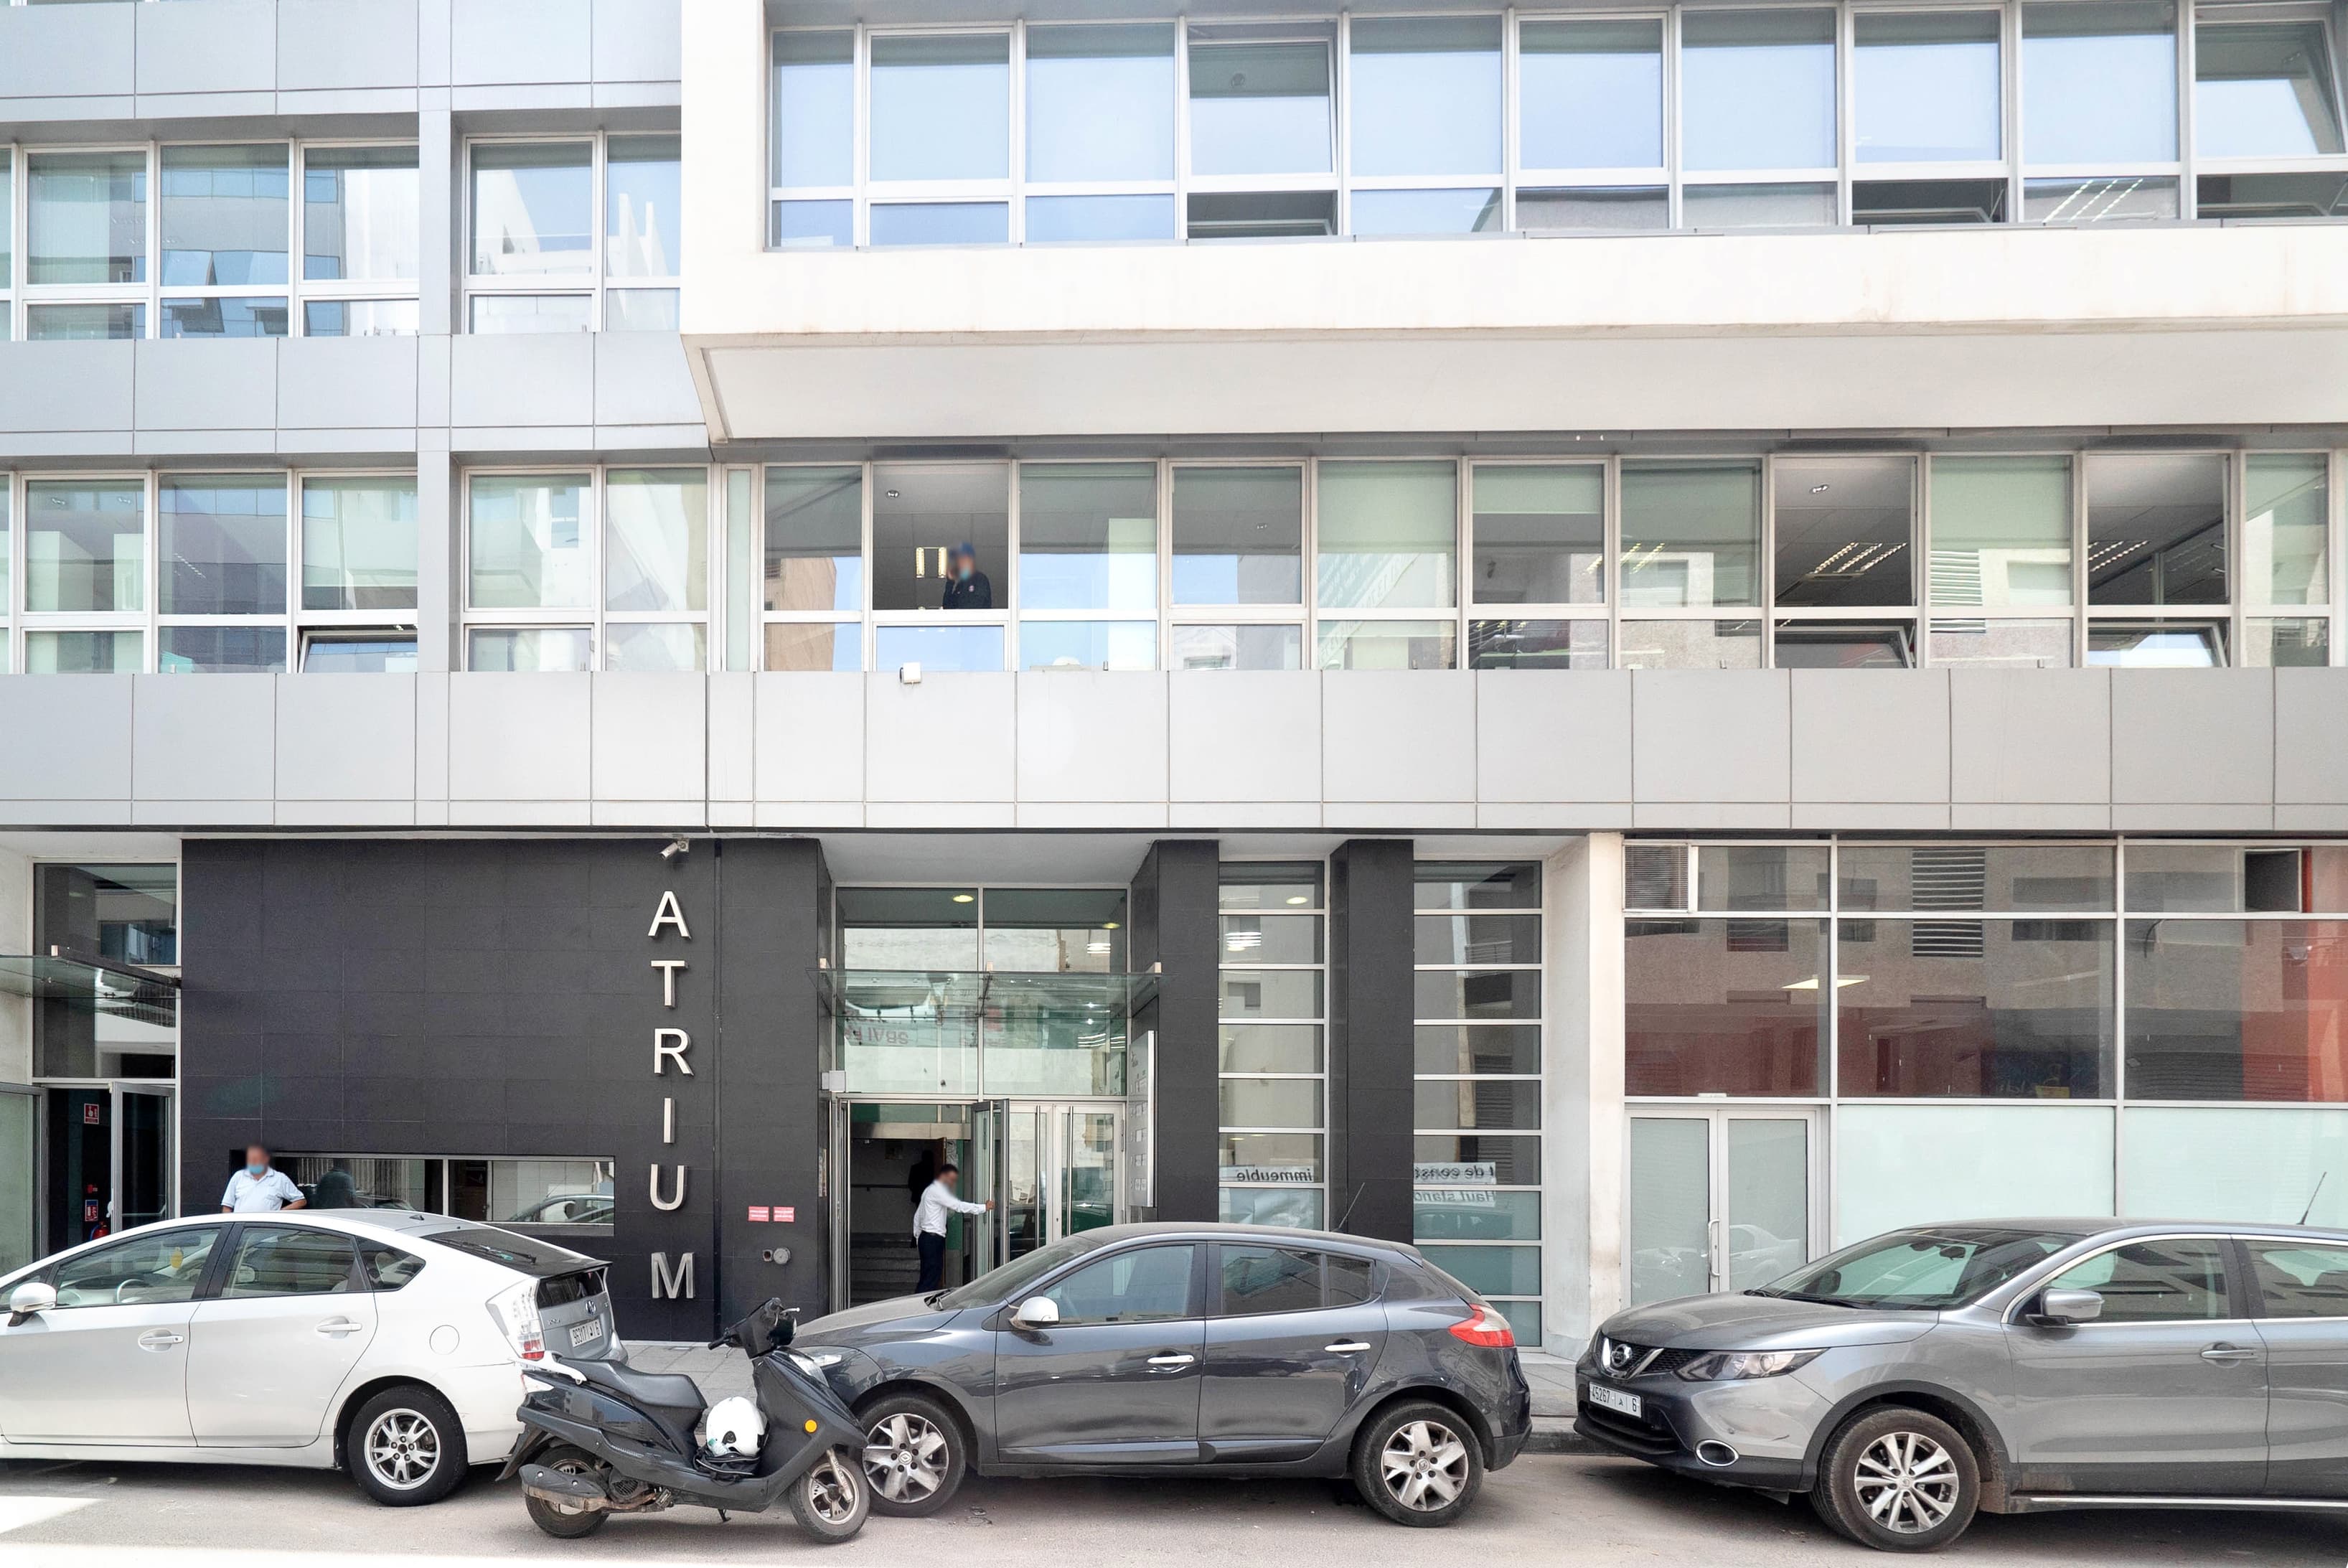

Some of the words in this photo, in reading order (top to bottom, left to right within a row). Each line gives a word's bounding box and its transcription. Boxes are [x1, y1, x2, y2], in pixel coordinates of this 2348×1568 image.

[647, 891, 695, 1299] ATRIUM
[1592, 1386, 1610, 1404] 45267
[1632, 1398, 1637, 1412] 6
